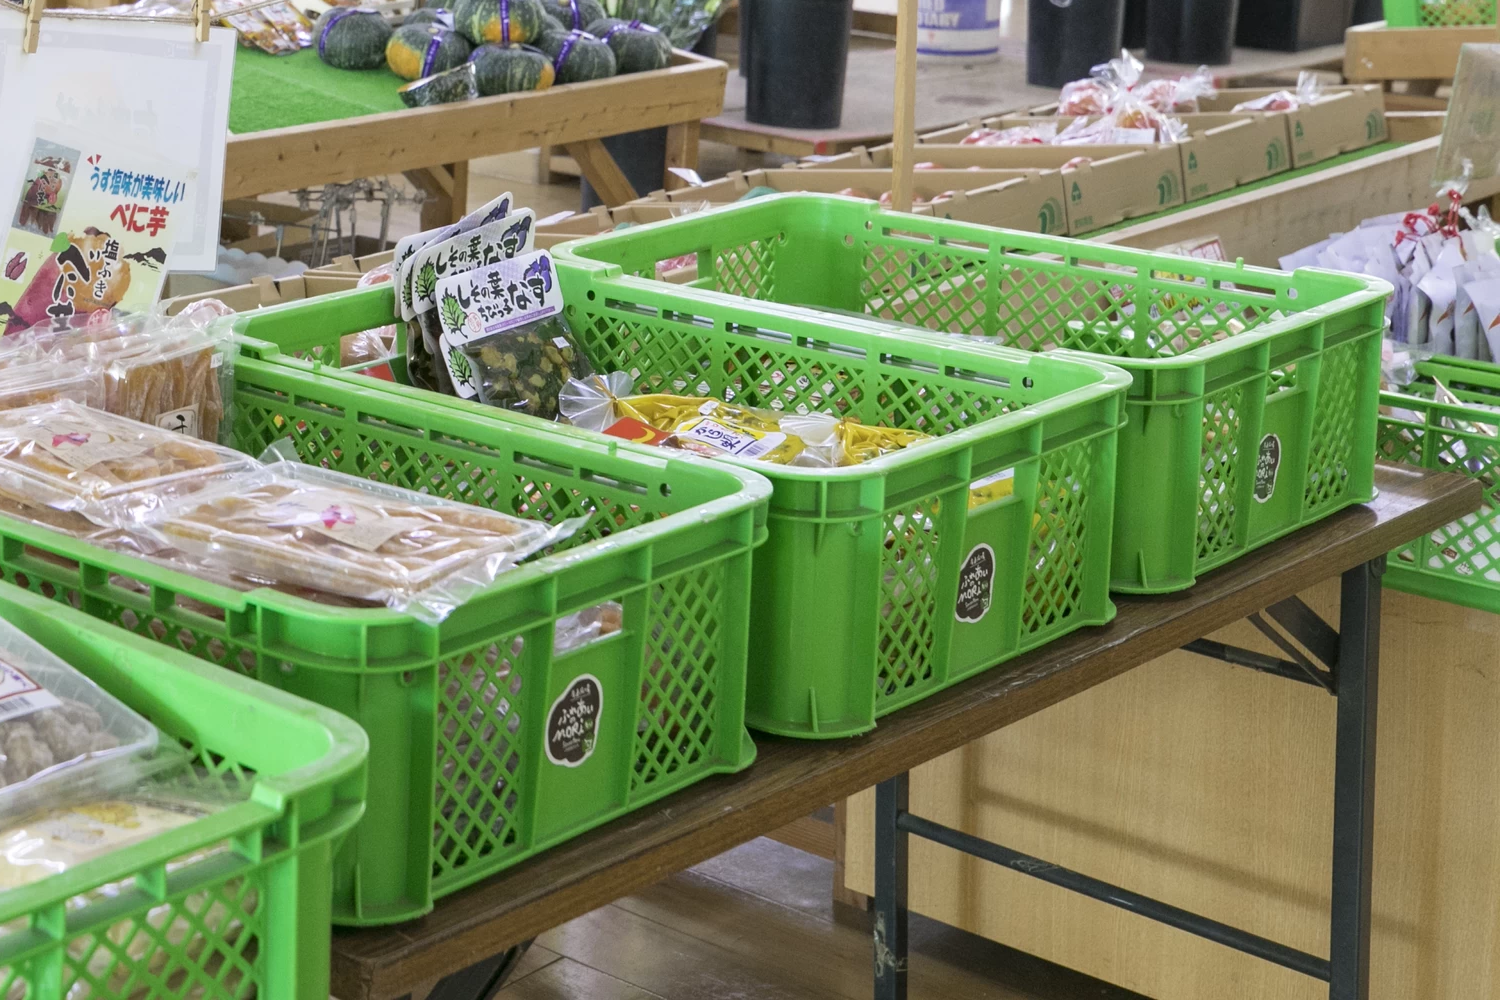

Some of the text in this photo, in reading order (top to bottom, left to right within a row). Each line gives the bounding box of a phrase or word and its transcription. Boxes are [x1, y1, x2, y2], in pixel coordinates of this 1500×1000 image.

[90, 165, 187, 205] うす塩味が美味しい
[109, 202, 170, 238] べに芋
[97, 238, 120, 299] 塩ふき
[435, 233, 482, 276] しその葉
[456, 269, 504, 310] しその葉
[506, 275, 546, 311] なす
[477, 298, 514, 323] ちびっ子
